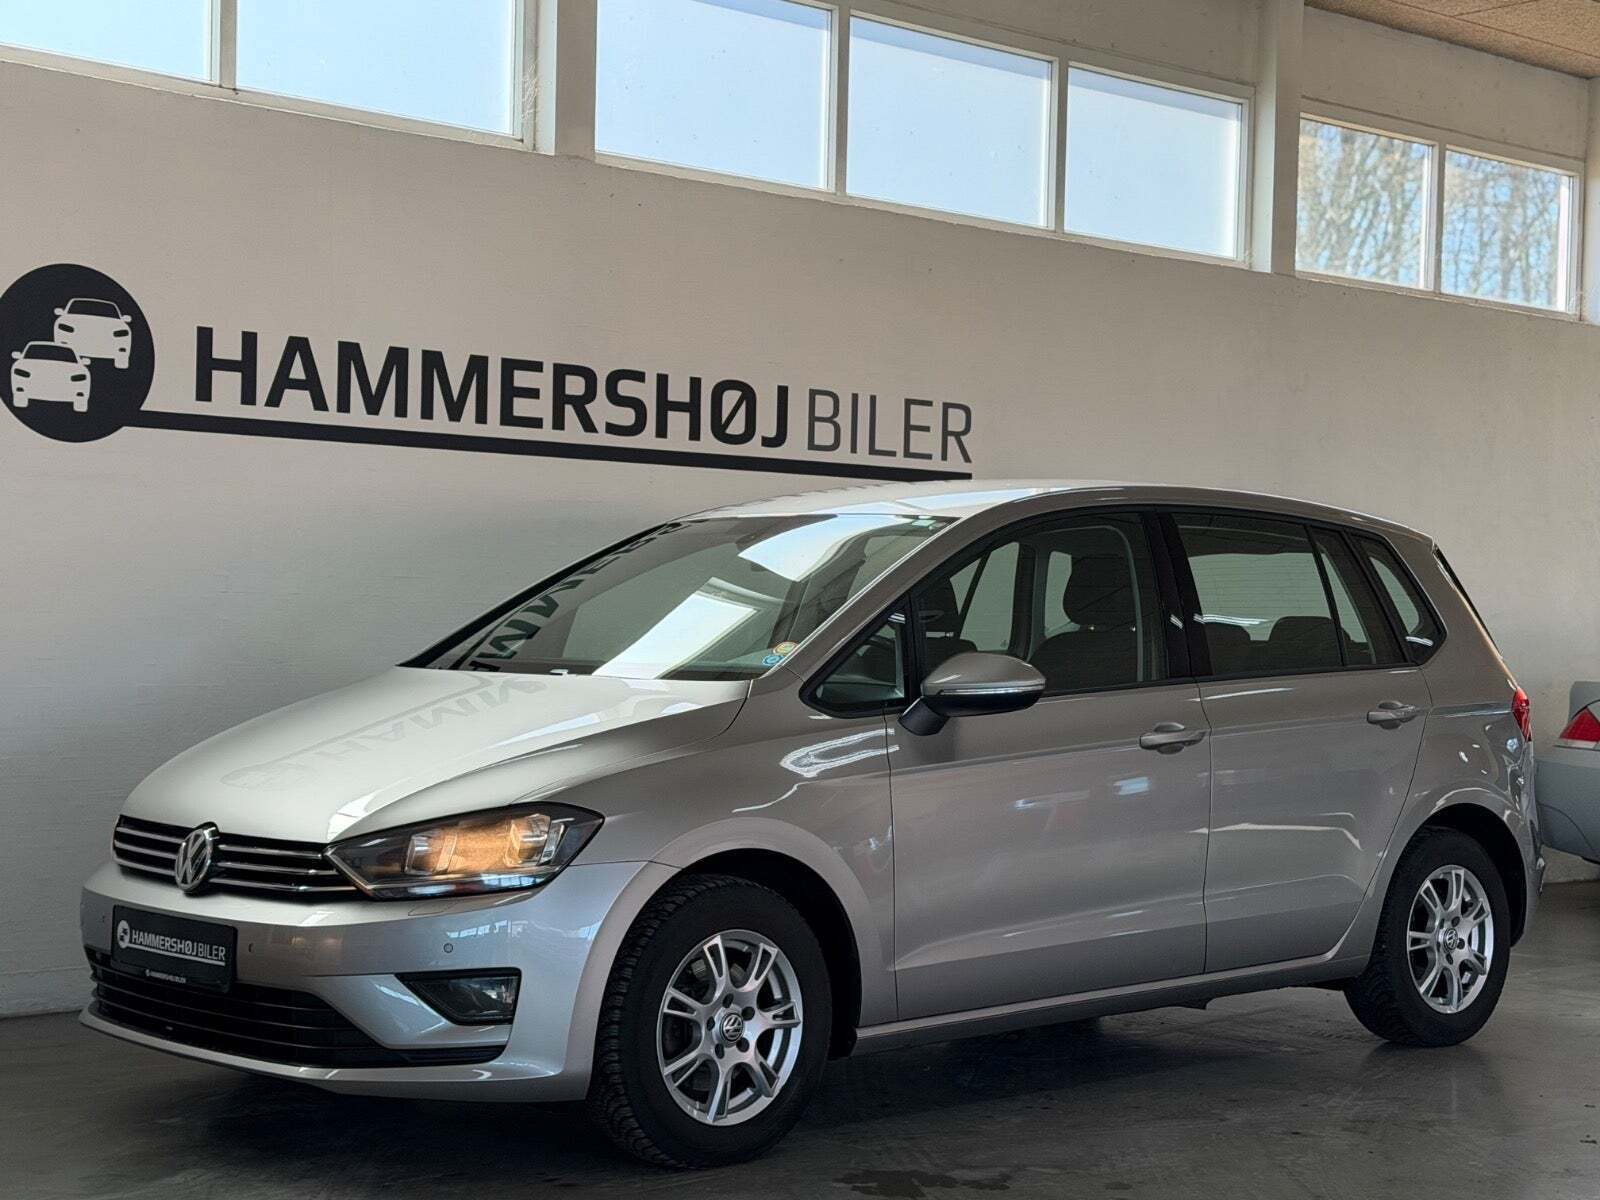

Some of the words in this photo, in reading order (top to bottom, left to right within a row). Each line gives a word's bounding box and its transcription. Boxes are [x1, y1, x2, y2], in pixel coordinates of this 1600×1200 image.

[196, 325, 789, 449] HAMMERSHØJ
[807, 388, 972, 465] BILER
[132, 929, 197, 956] HAMMERSHØJ
[197, 944, 226, 961] BILER
